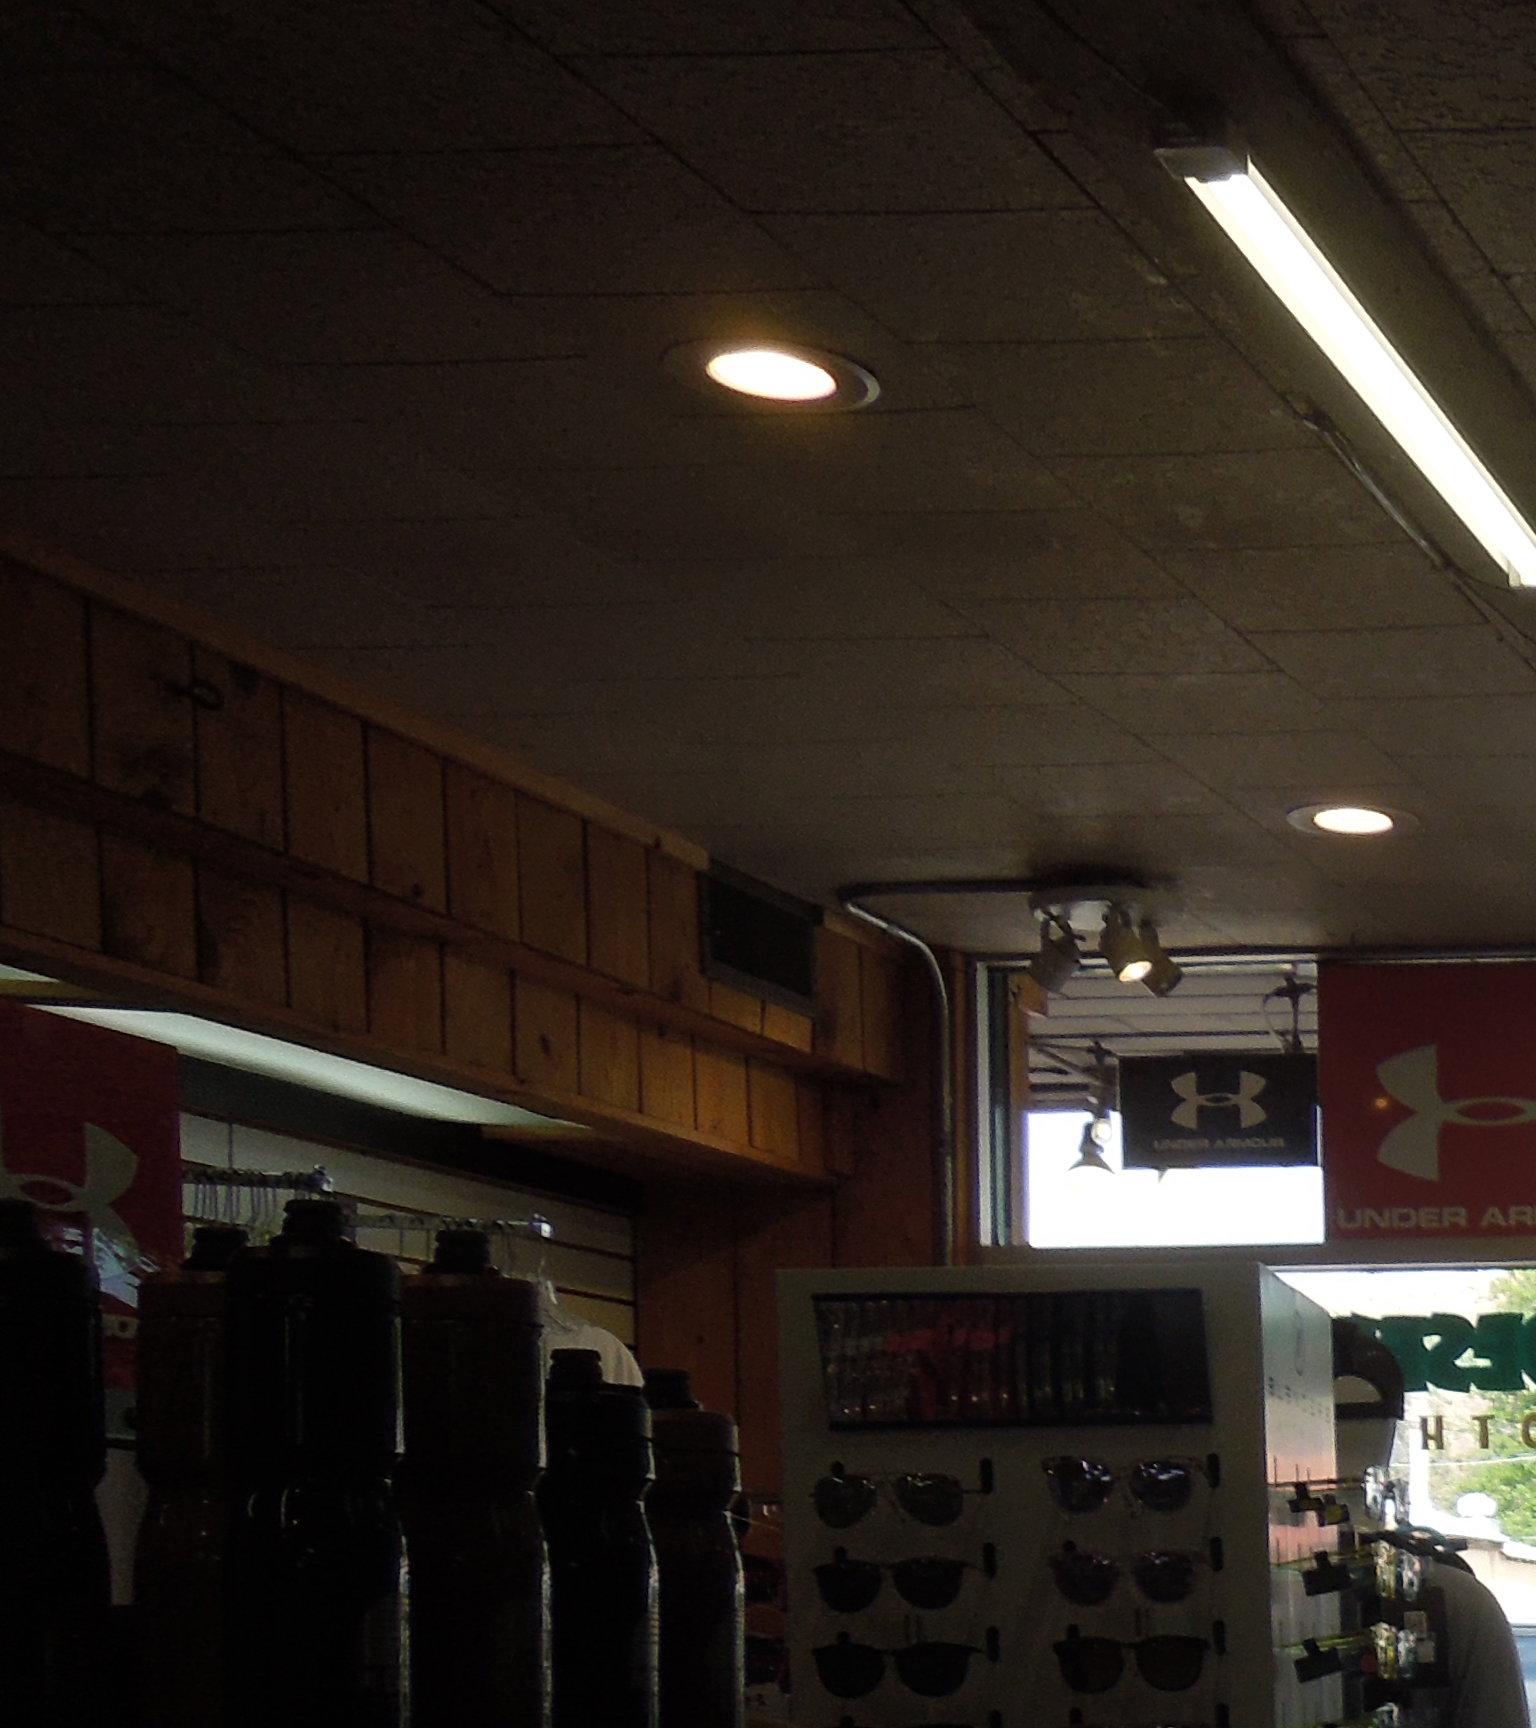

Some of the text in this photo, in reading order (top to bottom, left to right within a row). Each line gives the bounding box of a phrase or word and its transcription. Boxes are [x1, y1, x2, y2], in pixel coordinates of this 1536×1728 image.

[1153, 1136, 1286, 1150] UNDER ARMOUR
[1336, 1206, 1469, 1230] UNDER
